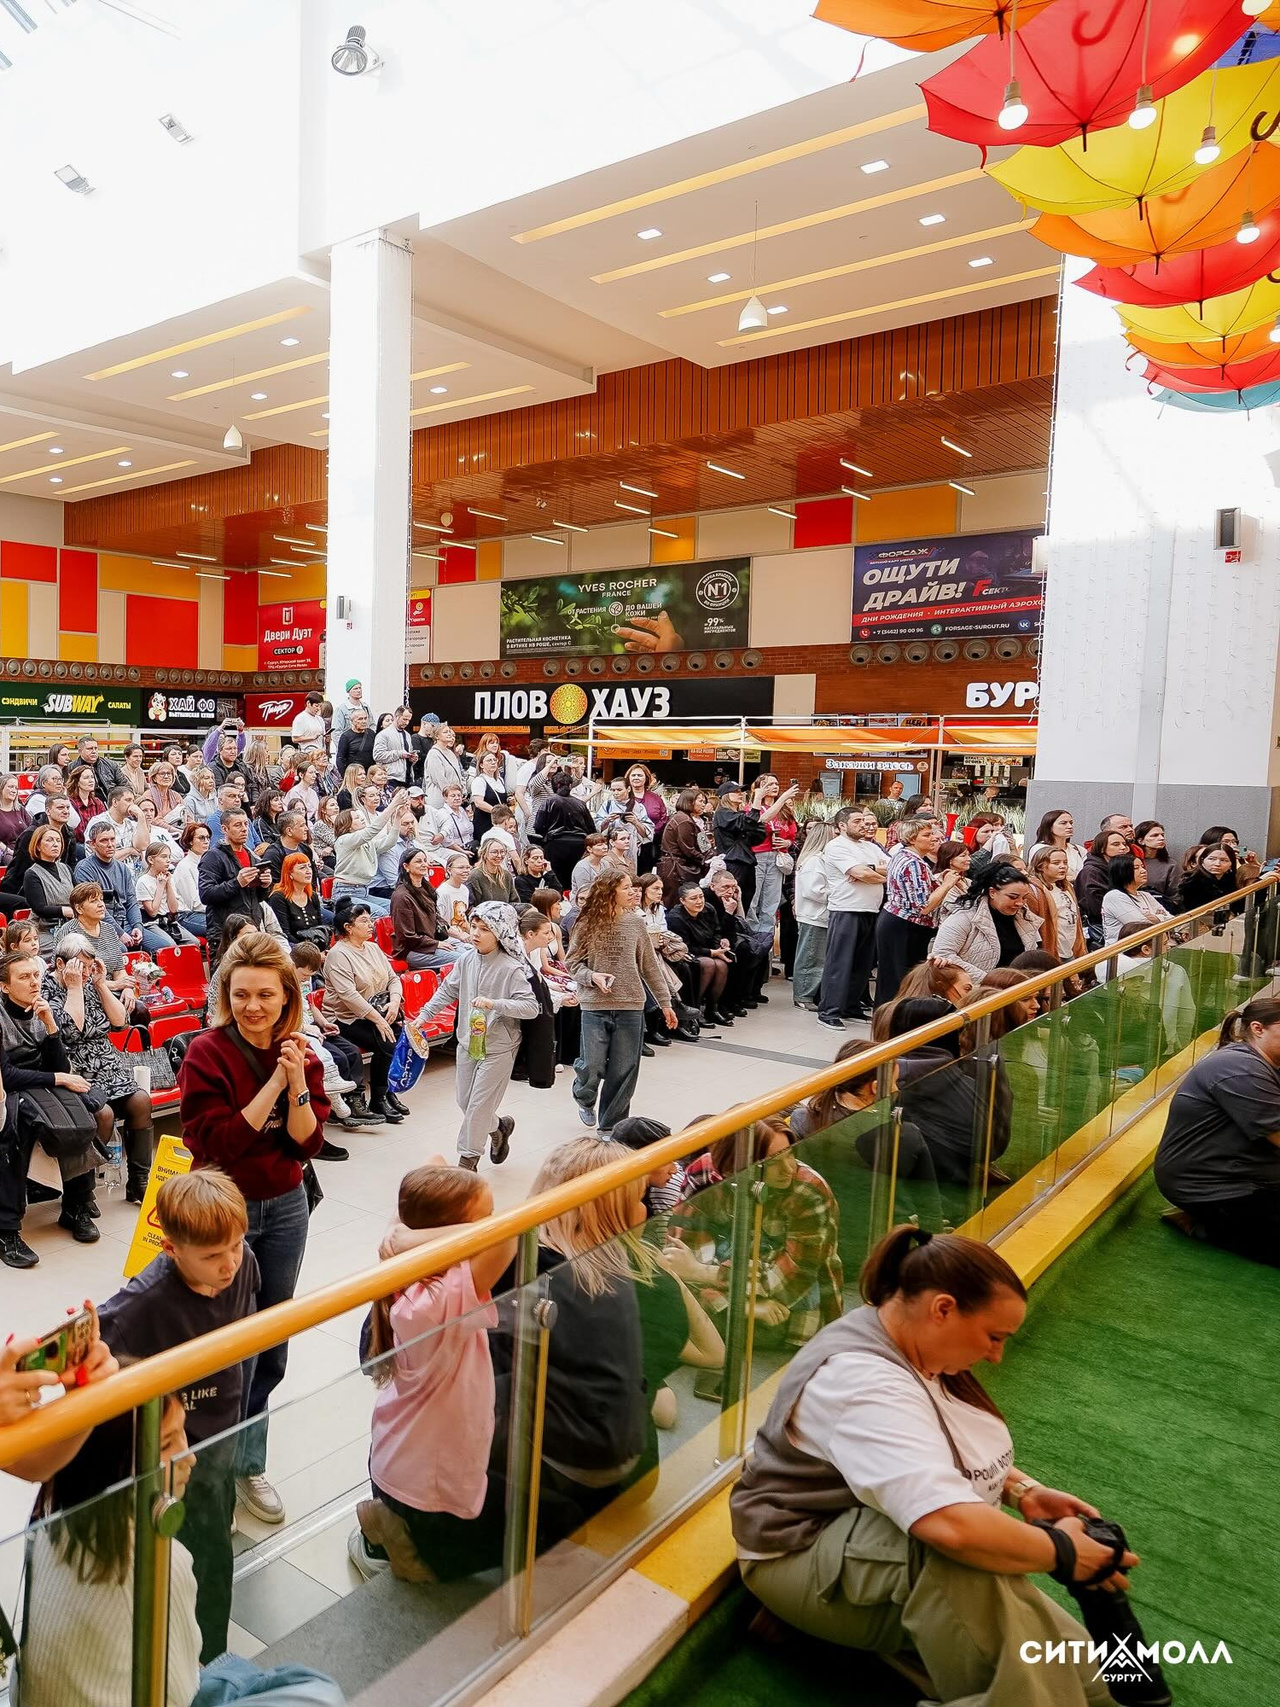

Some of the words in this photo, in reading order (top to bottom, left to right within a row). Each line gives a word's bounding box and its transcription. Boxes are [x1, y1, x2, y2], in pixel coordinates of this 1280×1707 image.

[878, 548, 929, 559] ФОРСАЖ
[863, 558, 960, 586] ОЩУТИ
[578, 582, 606, 593] YVES
[609, 578, 658, 590] ROCHER
[601, 590, 632, 598] FRANCE
[862, 580, 967, 612] ДРАЙВ!
[861, 616, 879, 624] ДНИ
[879, 611, 924, 622] РОЖДЕНИЯ
[934, 601, 1008, 615] ИНТЕРАКТИВНЫЙ
[263, 629, 291, 643] Двери
[291, 627, 313, 641] Дуэт
[945, 623, 1010, 632] FORSAGE-SURGUT.RU
[965, 681, 1040, 708] БУР
[1, 697, 38, 706] СЭНДВИЧИ
[41, 692, 104, 715] SUBWAY
[168, 695, 195, 711] ХАЙ
[474, 690, 548, 720] ПЛОВ
[590, 687, 671, 719] ХАУЗ
[191, 1386, 218, 1400] LIKE
